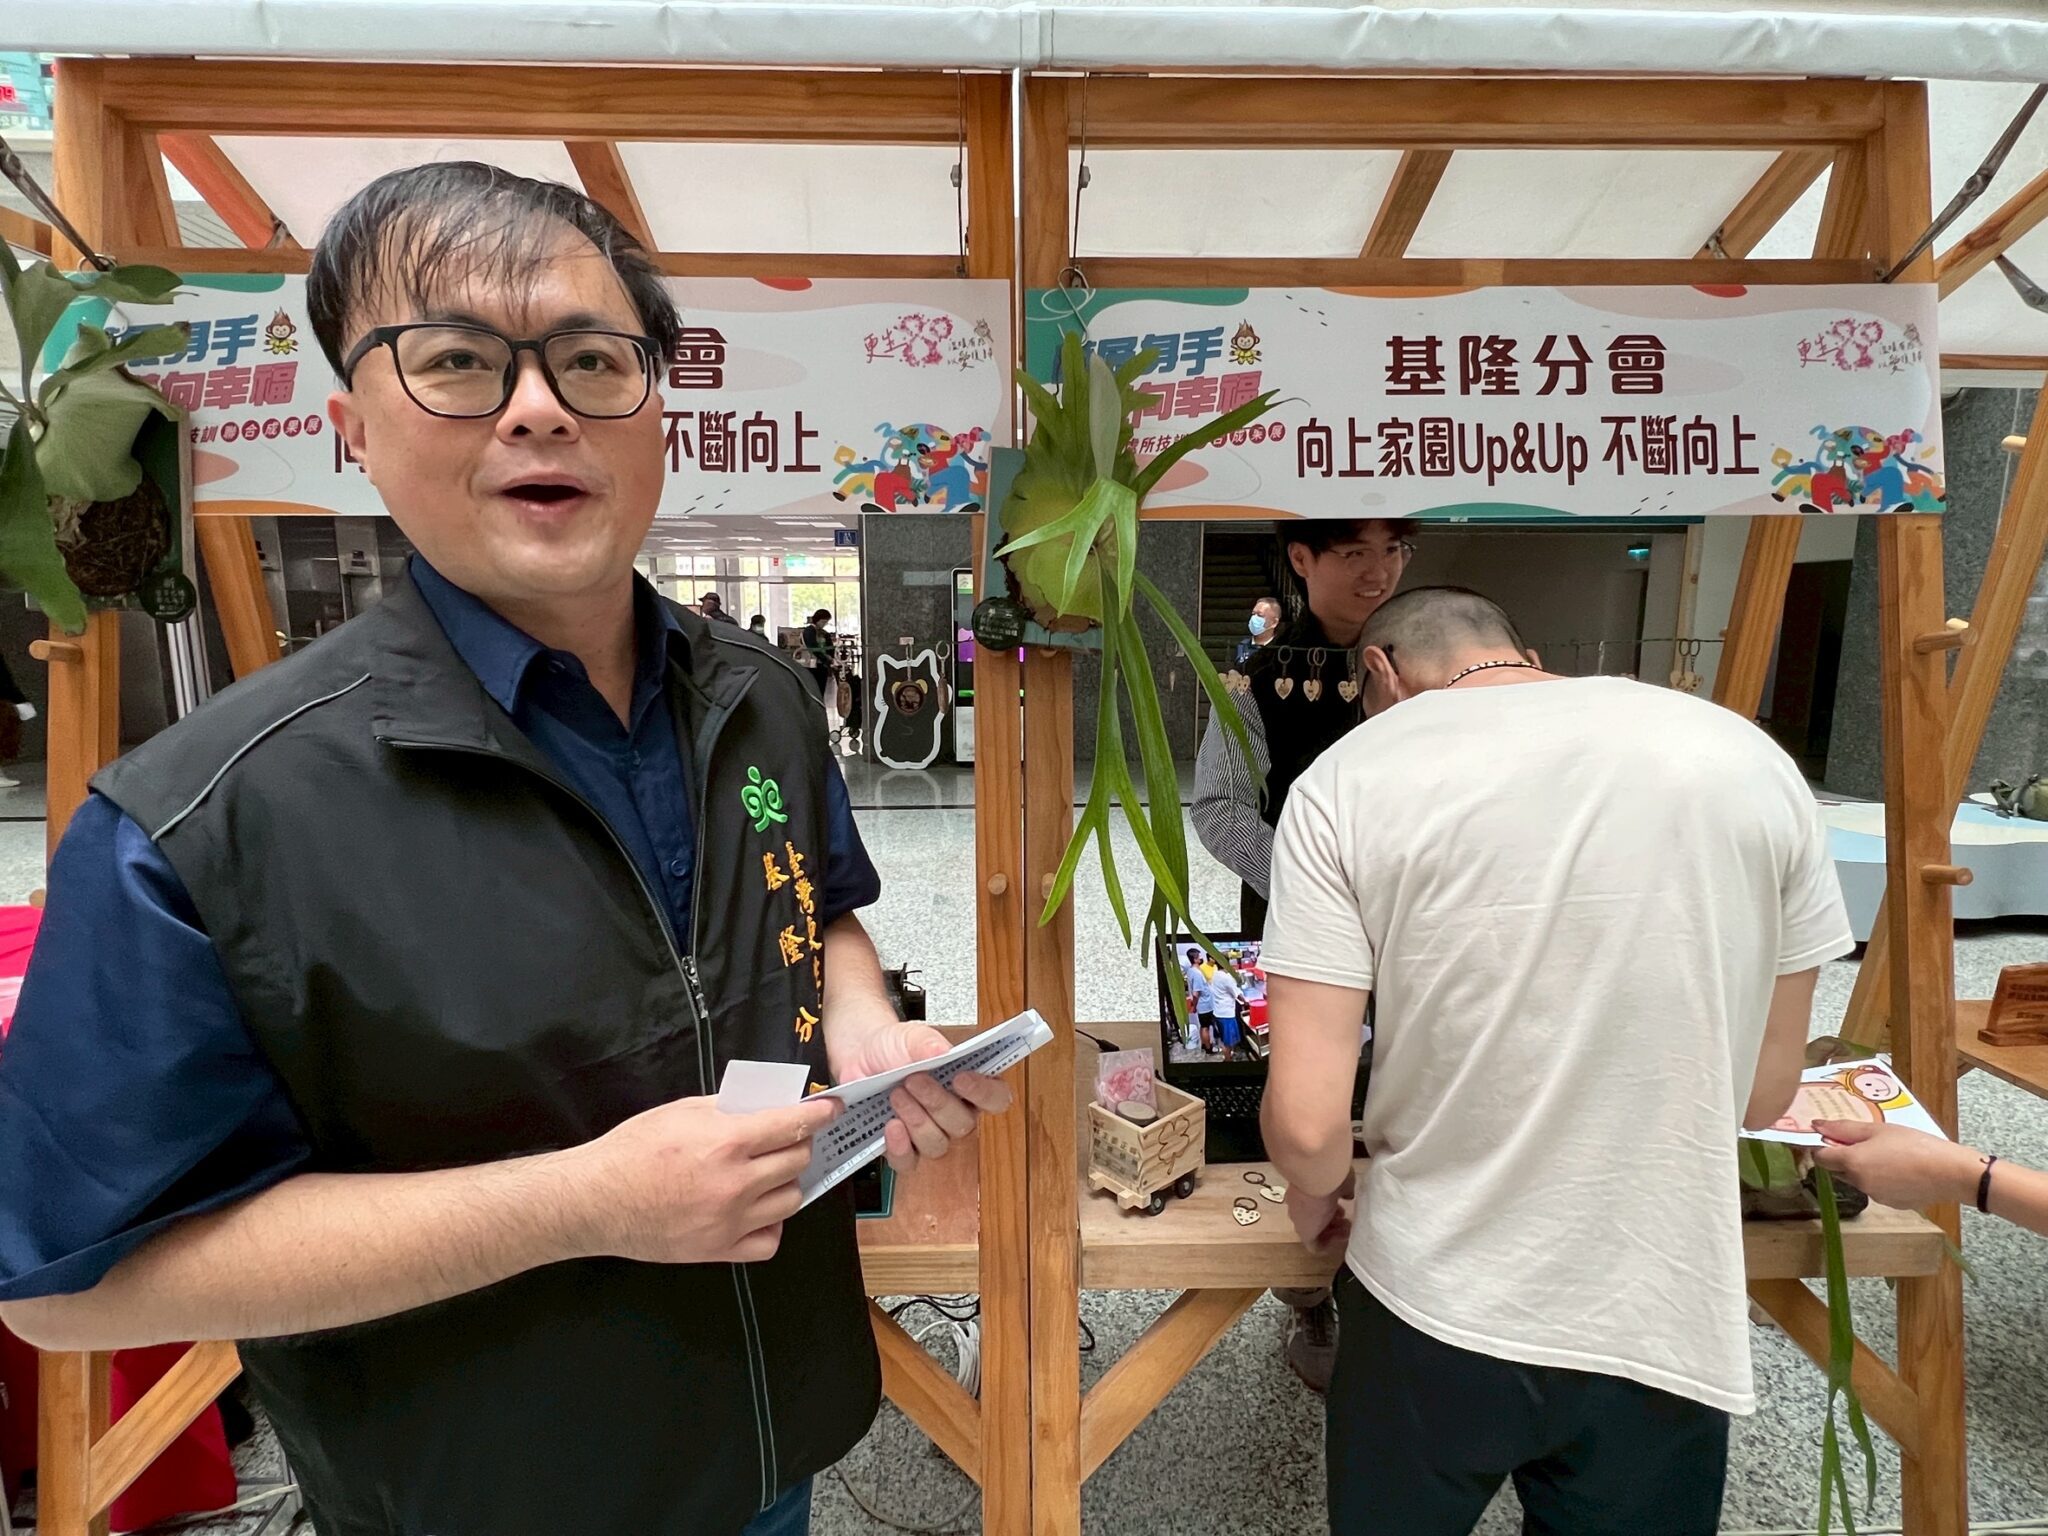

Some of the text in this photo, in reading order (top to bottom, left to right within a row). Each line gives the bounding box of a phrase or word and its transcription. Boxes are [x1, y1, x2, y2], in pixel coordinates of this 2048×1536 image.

[1385, 335, 1667, 396] 基隆分會
[663, 410, 821, 472] 不斷向上
[1297, 414, 1760, 487] 向上家園Up&Up 不斷向上
